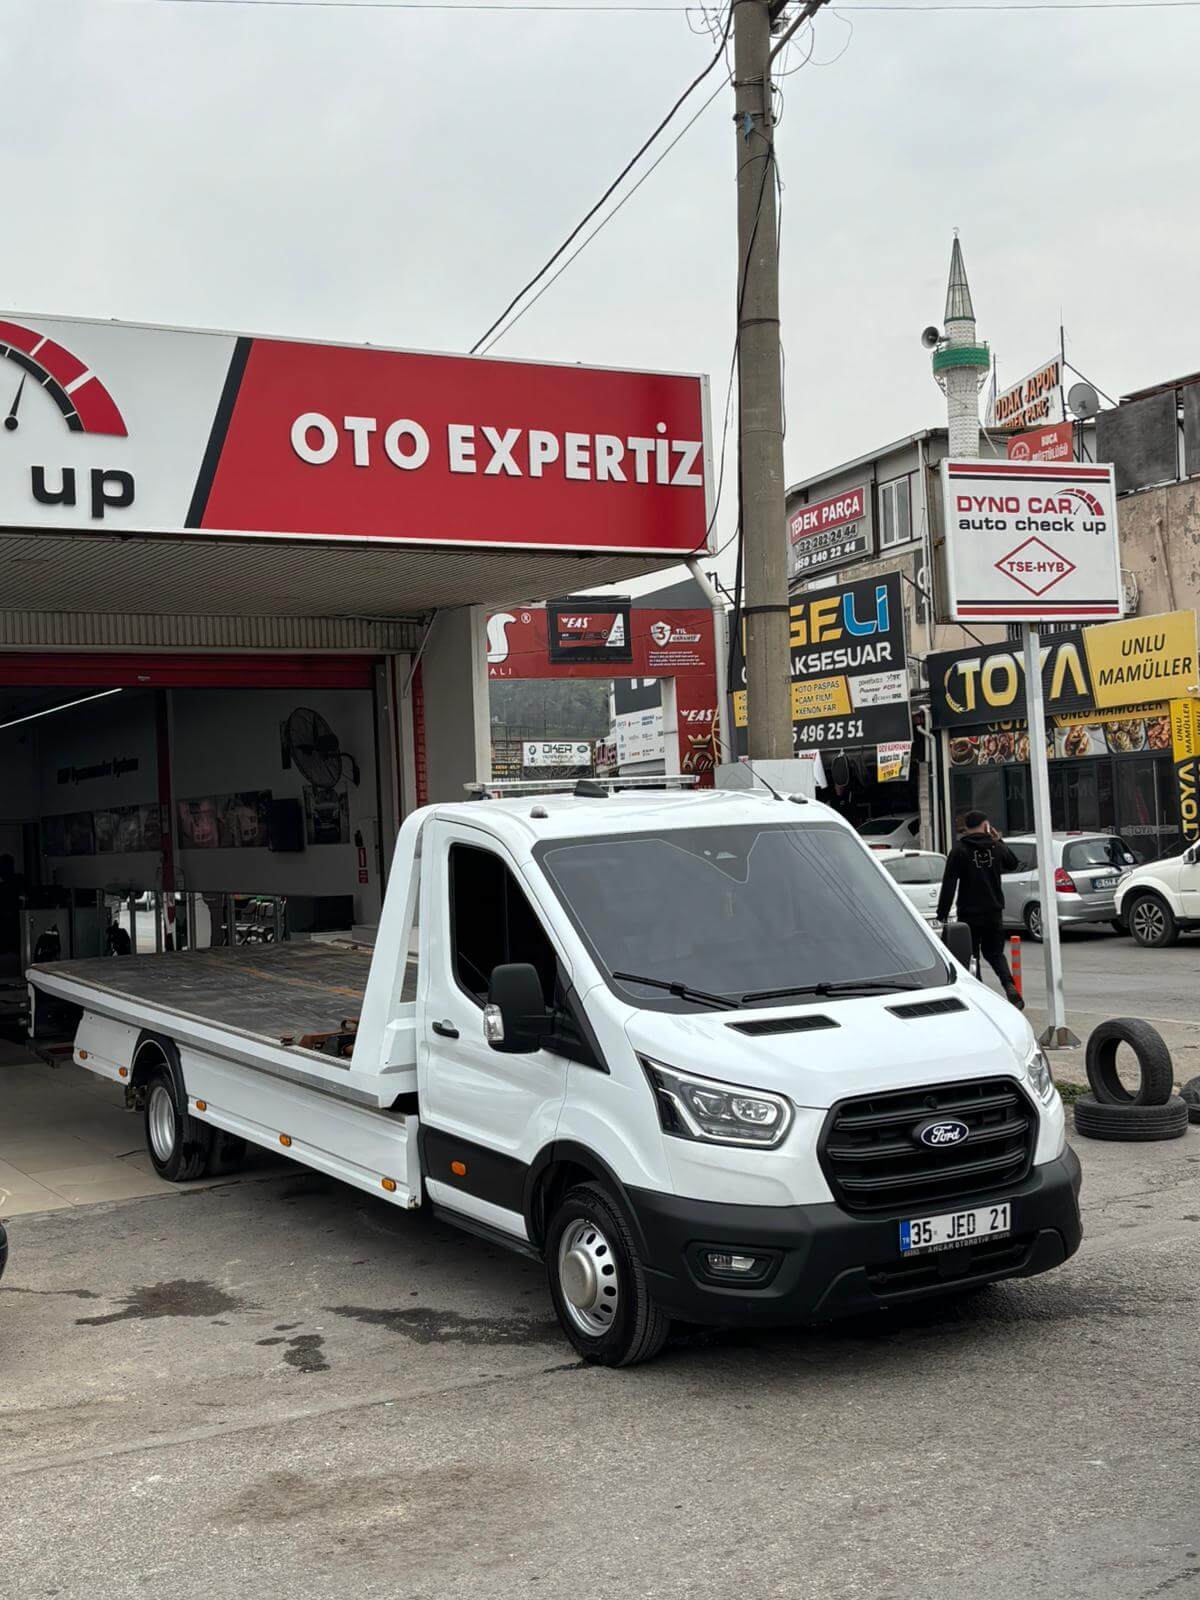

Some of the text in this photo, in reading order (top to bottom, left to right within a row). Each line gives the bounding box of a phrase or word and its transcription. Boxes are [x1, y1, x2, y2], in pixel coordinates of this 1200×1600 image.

[1024, 362, 1059, 403] JAPON
[290, 411, 703, 487] OTO EXPERTİZ
[30, 465, 136, 519] up
[956, 495, 1072, 514] DYNO CAR
[822, 496, 860, 524] PARÇA
[844, 524, 857, 537] 44
[958, 517, 1107, 535] auto check up
[811, 551, 828, 565] 840
[830, 547, 841, 559] 22
[844, 541, 856, 553] 44
[1007, 561, 1065, 572] TSE-HYB
[656, 626, 665, 640] 3
[1122, 633, 1166, 657] UNLU
[1099, 656, 1193, 687] MAMÜLLER
[801, 724, 824, 743] 496
[827, 722, 844, 740] 25
[847, 719, 864, 738] 51
[1175, 717, 1183, 743] UNLU
[1182, 703, 1194, 753] MAMÜLLER
[1179, 763, 1199, 835] TOYA
[931, 1125, 960, 1143] Ford
[911, 1220, 932, 1246] 35
[946, 1212, 976, 1239] JED
[990, 1206, 1008, 1232] 21
